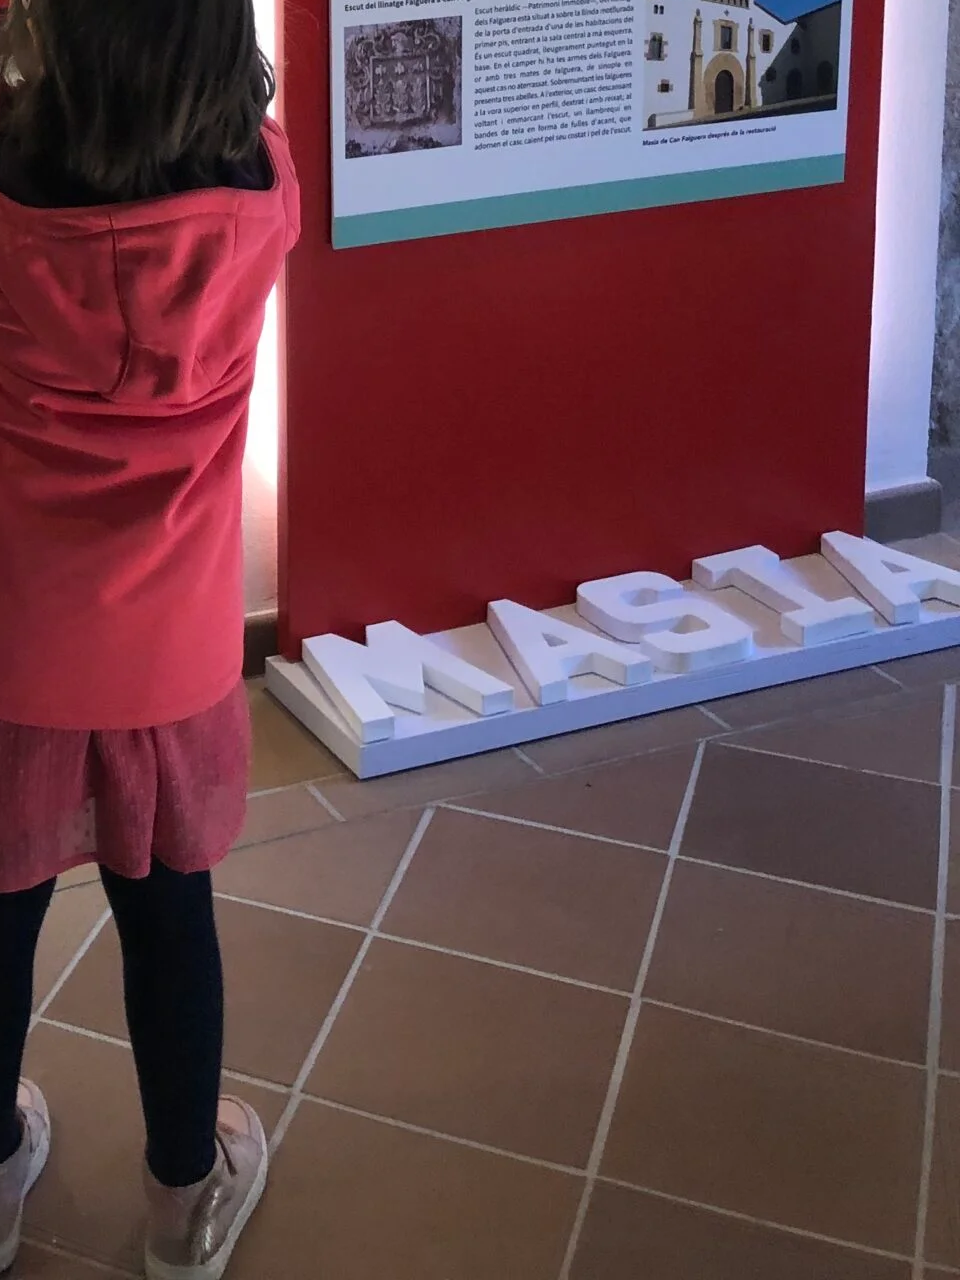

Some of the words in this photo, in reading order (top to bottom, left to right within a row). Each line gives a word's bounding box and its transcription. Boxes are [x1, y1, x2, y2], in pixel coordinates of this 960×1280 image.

[344, 3, 364, 12] Escut
[365, 1, 376, 10] del
[378, 0, 404, 10] llinatge
[302, 530, 960, 743] MASIA
